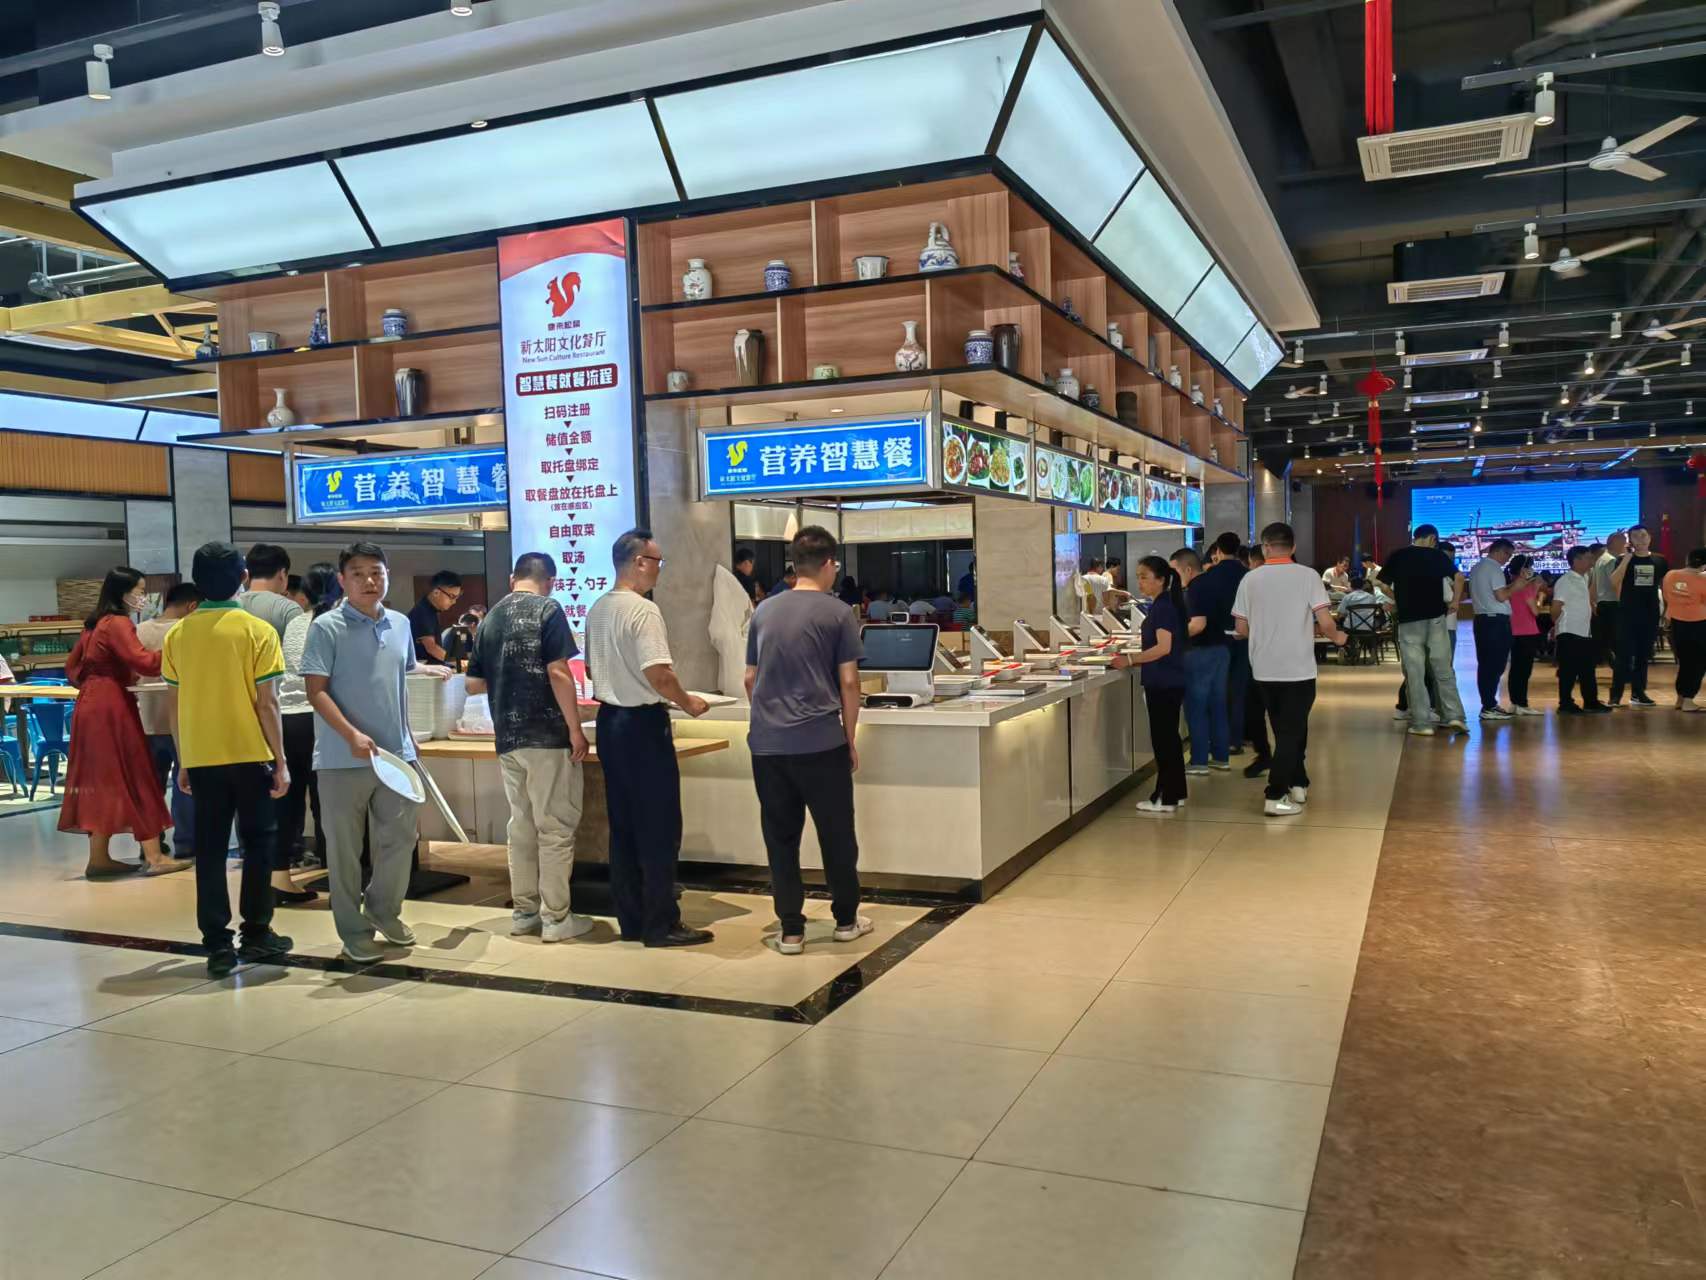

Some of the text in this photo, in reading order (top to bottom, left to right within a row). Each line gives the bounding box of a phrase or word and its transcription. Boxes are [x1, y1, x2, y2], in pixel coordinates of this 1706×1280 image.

[520, 330, 607, 355] 新太阳文化餐厅
[549, 352, 571, 361] Culture
[573, 349, 606, 359] Restaurant
[519, 367, 613, 393] 智慧餐就餐流程
[544, 402, 591, 420] 扫码注册
[545, 430, 592, 447] 储值金额
[759, 436, 913, 477] 营养智慧餐
[540, 457, 599, 475] 取托盘绑定
[525, 483, 619, 502] 取餐盘放在托盘上
[549, 523, 596, 538] 自由取菜
[562, 551, 585, 564] 取汤
[565, 604, 587, 617] 就餐
